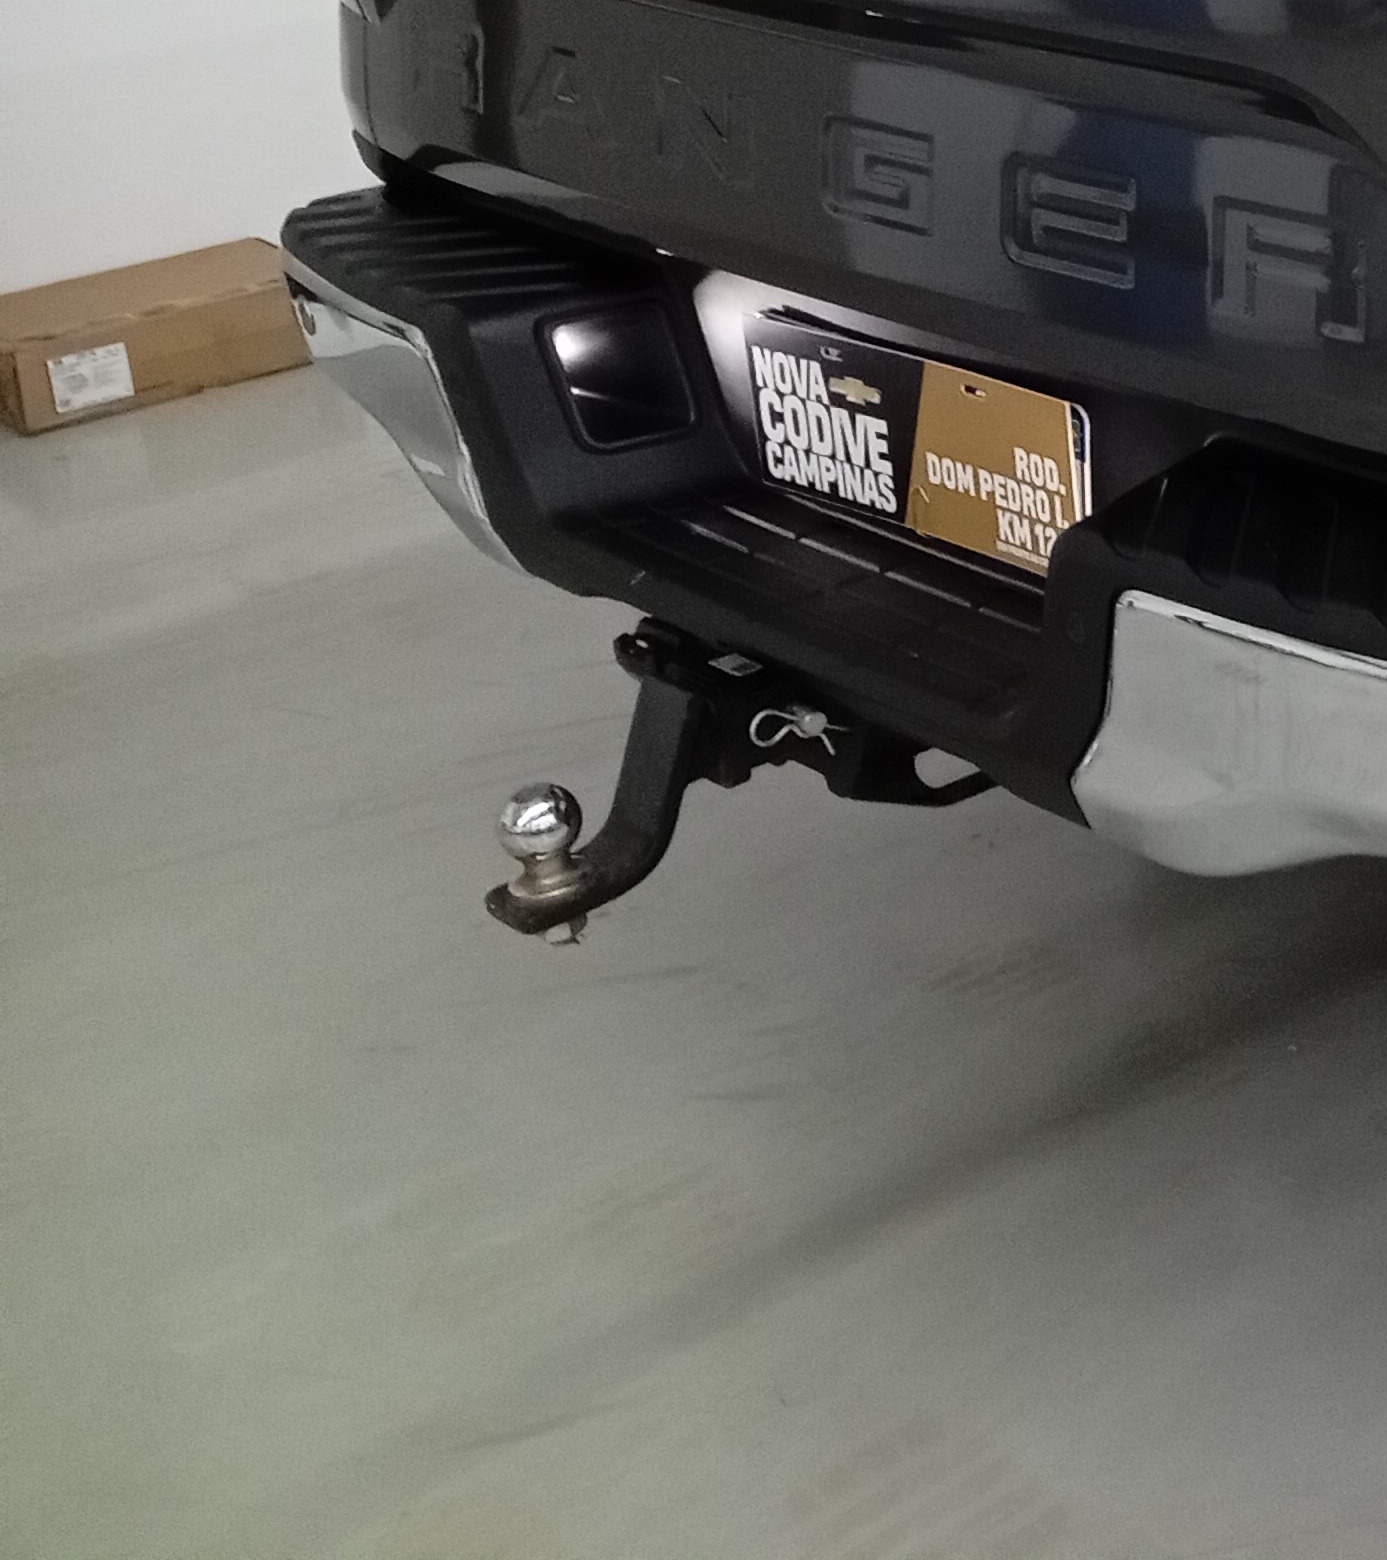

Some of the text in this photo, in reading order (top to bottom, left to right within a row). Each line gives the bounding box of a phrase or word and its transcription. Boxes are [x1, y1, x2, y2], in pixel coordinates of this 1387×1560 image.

[751, 344, 831, 405] NOVA
[758, 387, 894, 476] CODIVE
[765, 440, 897, 513] CAMPINAS
[925, 451, 976, 497] DOM
[977, 468, 1050, 523] PEDRO
[1013, 446, 1067, 497] ROD.
[996, 508, 1032, 551] KM
